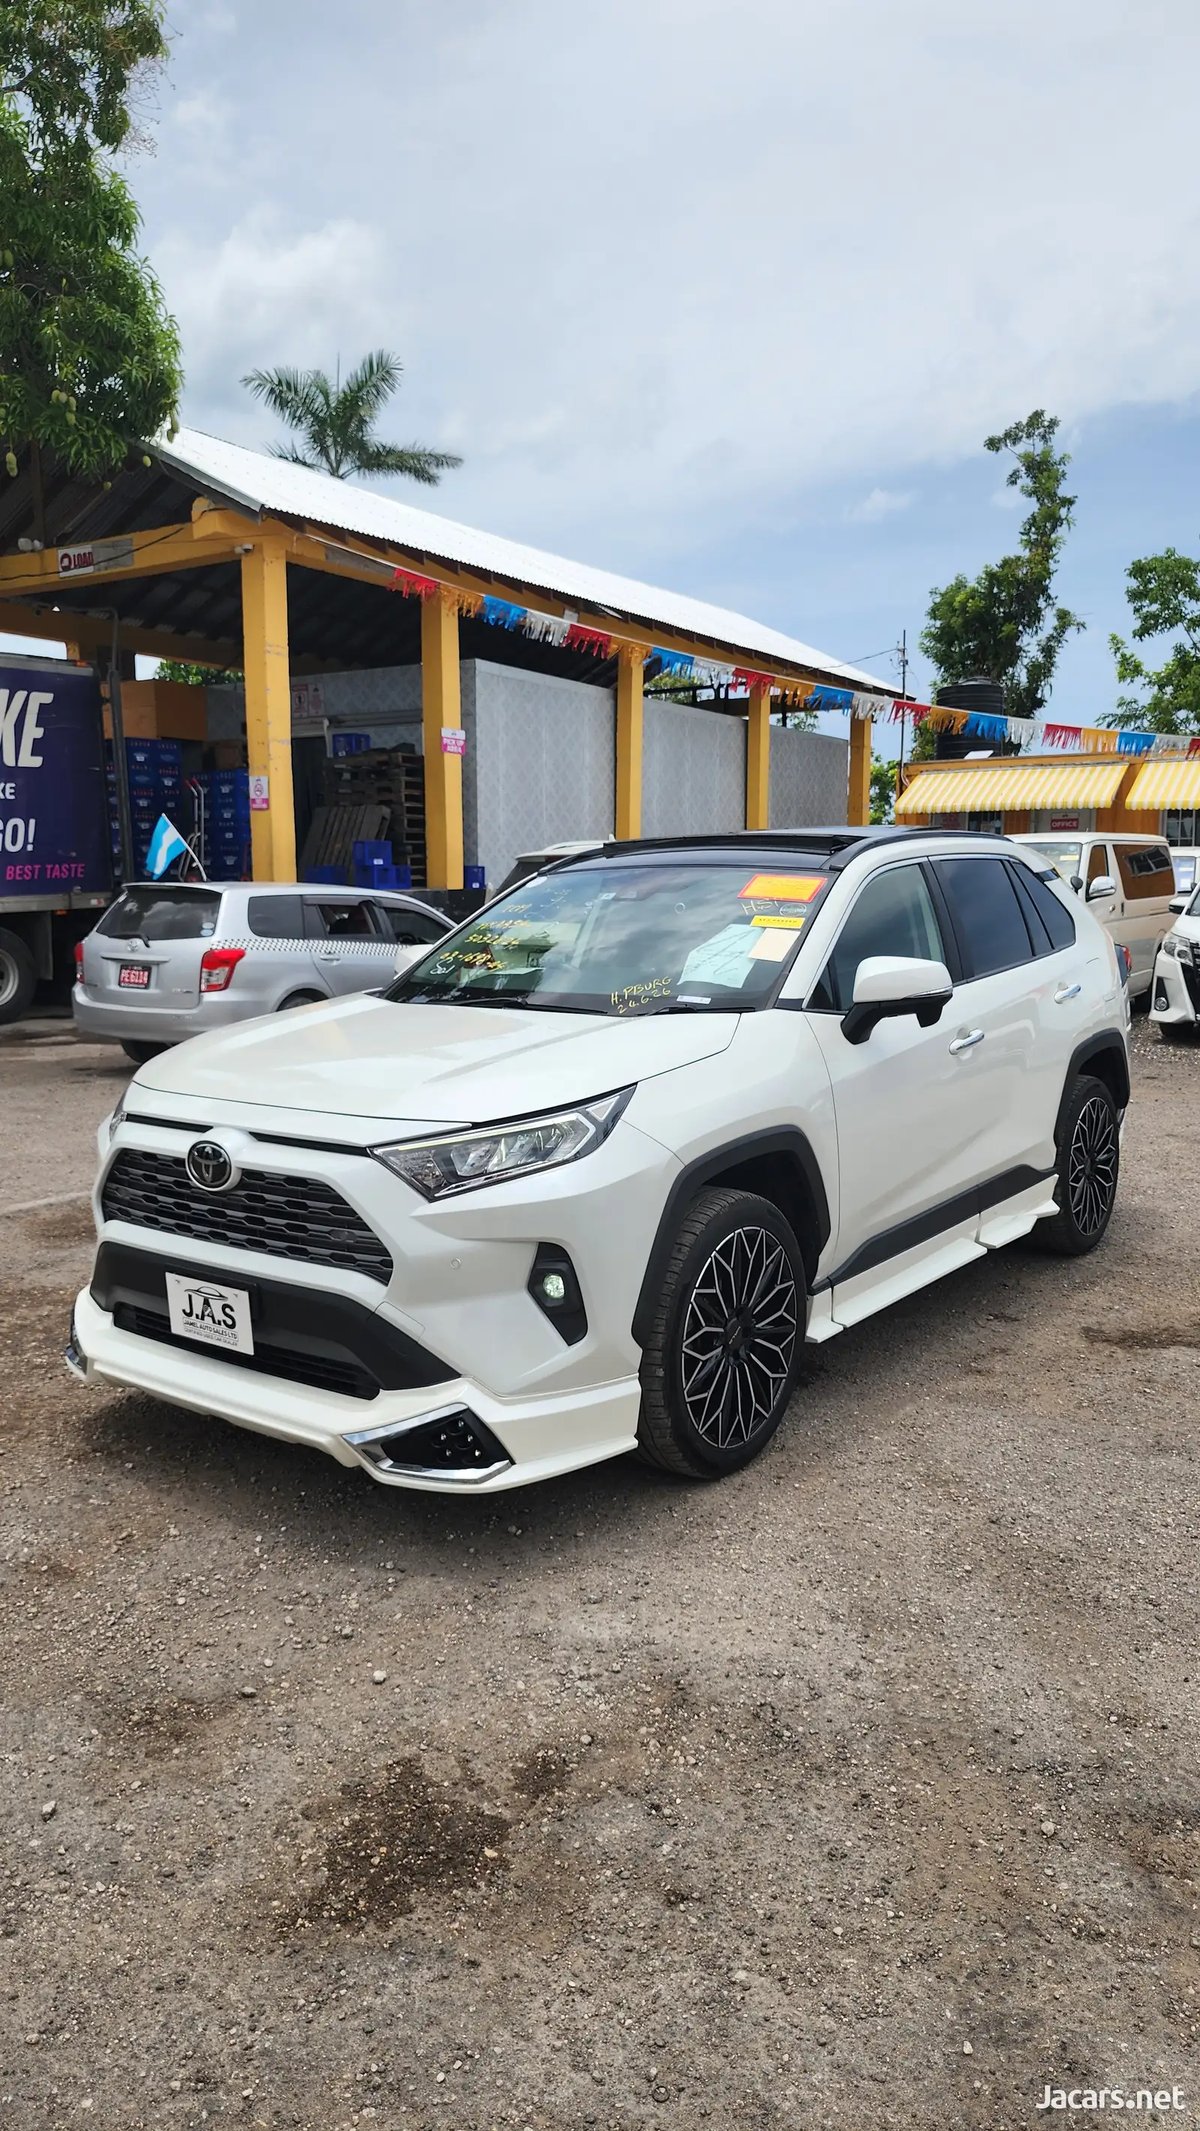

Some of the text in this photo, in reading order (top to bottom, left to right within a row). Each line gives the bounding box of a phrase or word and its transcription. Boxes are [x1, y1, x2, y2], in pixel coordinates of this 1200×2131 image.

[0, 817, 36, 853] O!
[5, 863, 86, 881] BEST TASTE
[199, 1324, 213, 1333] AUTO
